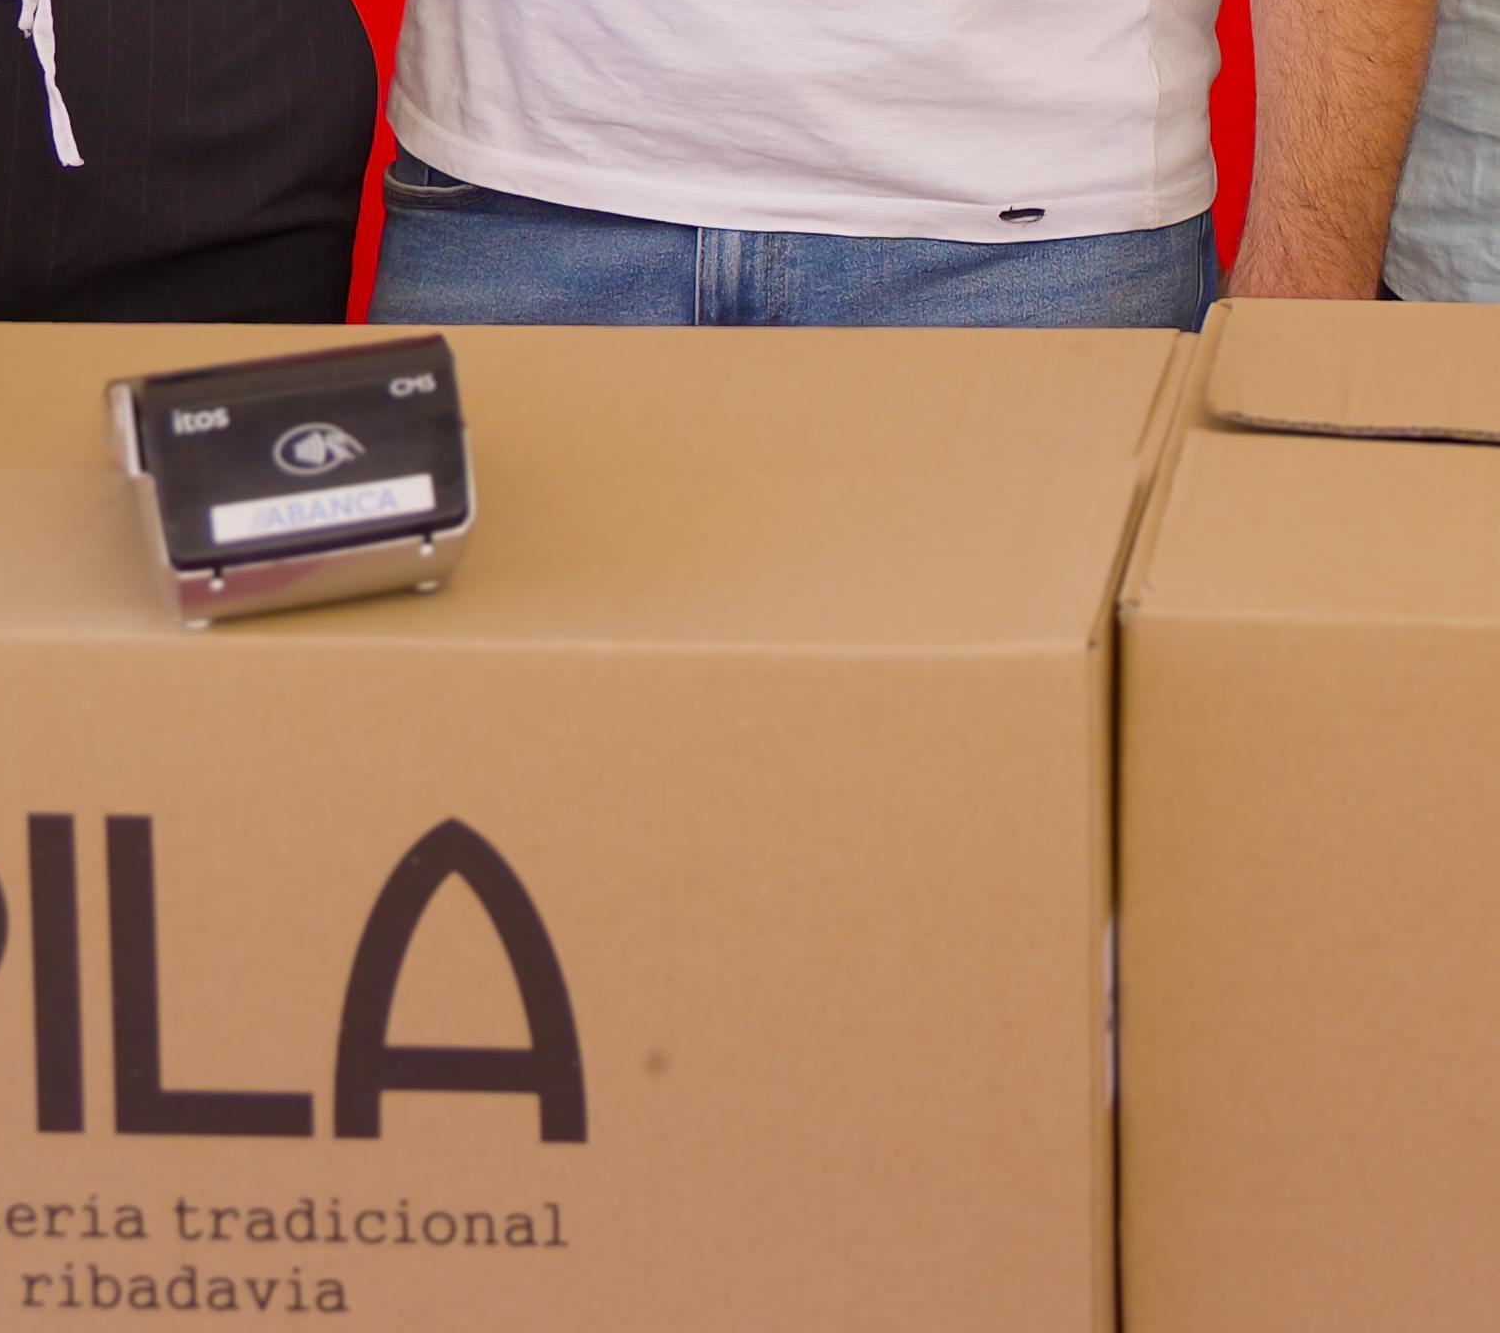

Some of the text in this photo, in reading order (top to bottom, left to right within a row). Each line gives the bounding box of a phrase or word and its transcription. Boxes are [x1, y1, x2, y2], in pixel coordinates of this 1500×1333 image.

[171, 406, 231, 436] itos
[265, 487, 399, 529] ABANCA
[174, 1195, 570, 1249] tradicional
[20, 1263, 349, 1314] ribadavia
